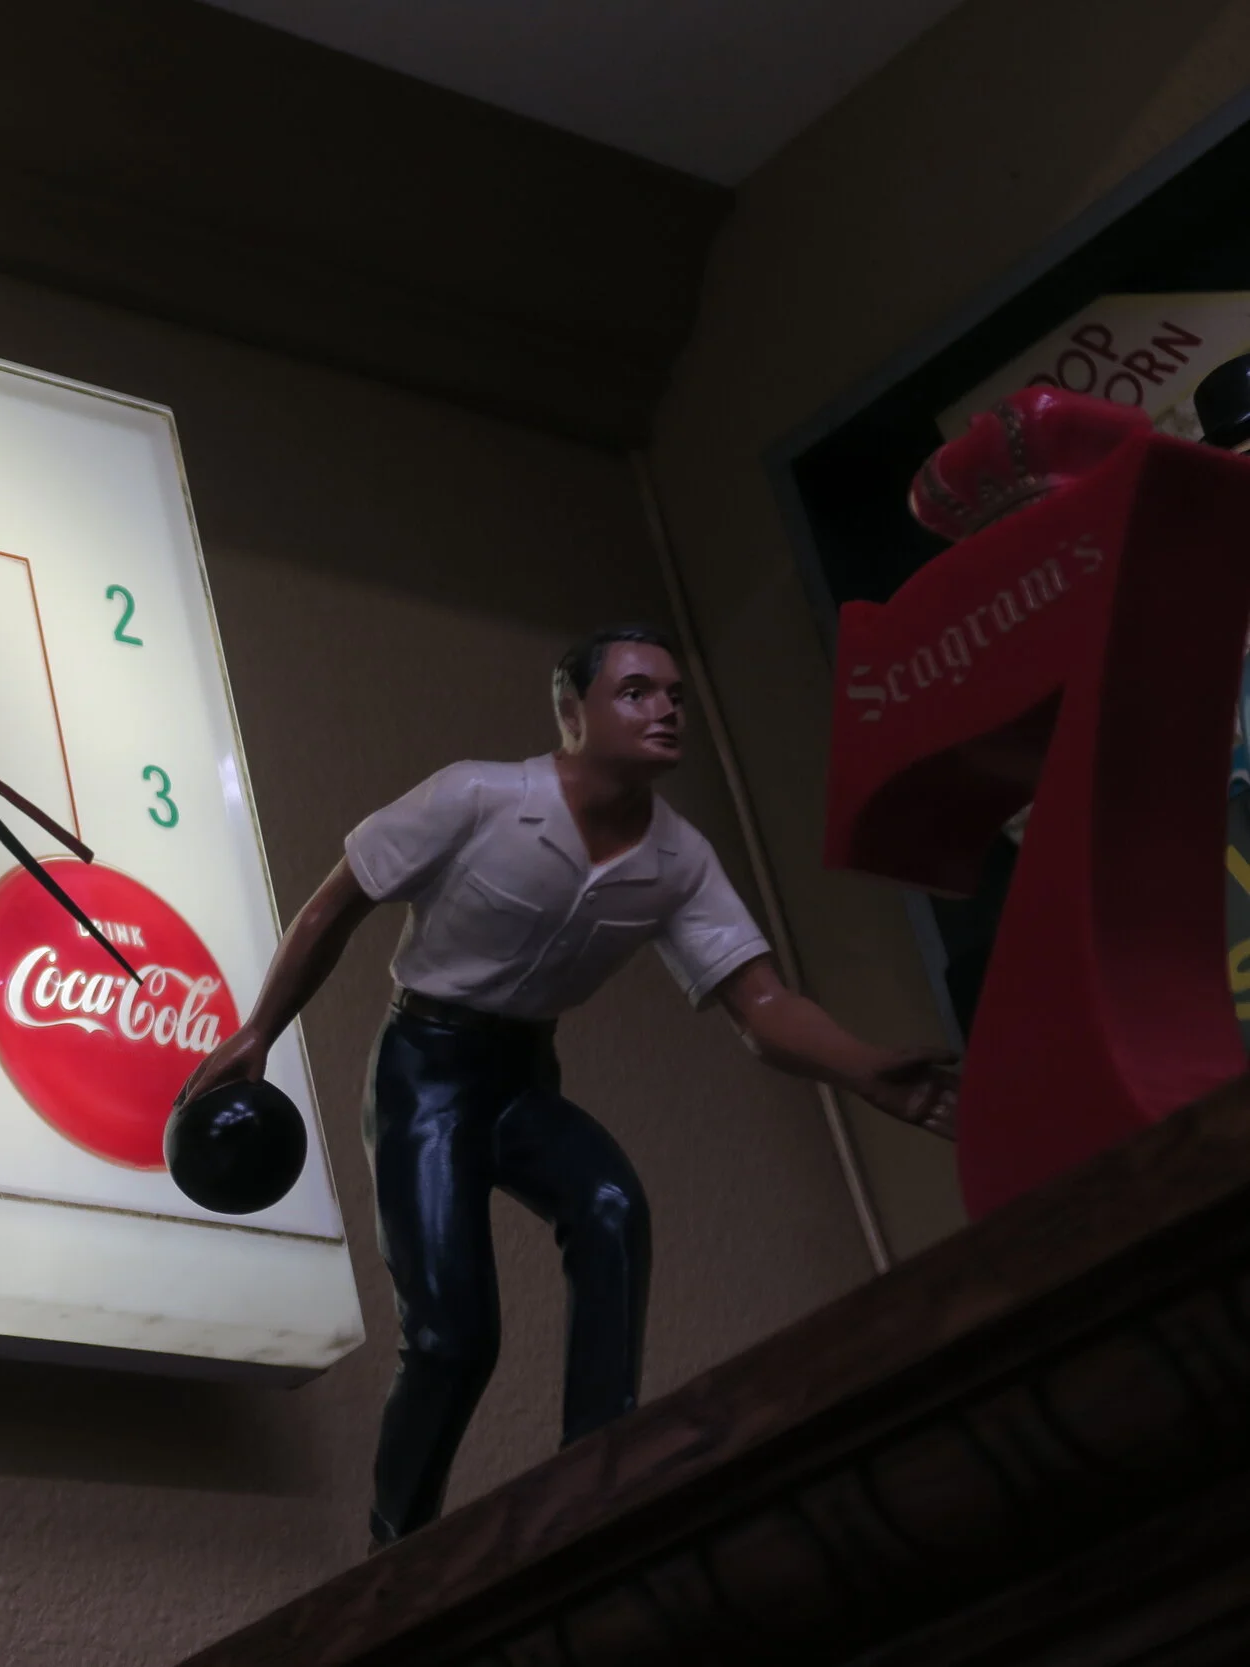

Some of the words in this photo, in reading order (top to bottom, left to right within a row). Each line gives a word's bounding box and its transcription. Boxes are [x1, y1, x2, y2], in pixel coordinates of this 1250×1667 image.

[1025, 323, 1119, 394] OP
[1104, 321, 1203, 407] ORN
[104, 584, 144, 647] 2
[846, 533, 1103, 722] Seagram's
[141, 764, 180, 829] 3
[6, 945, 221, 1055] Coca-Cola
